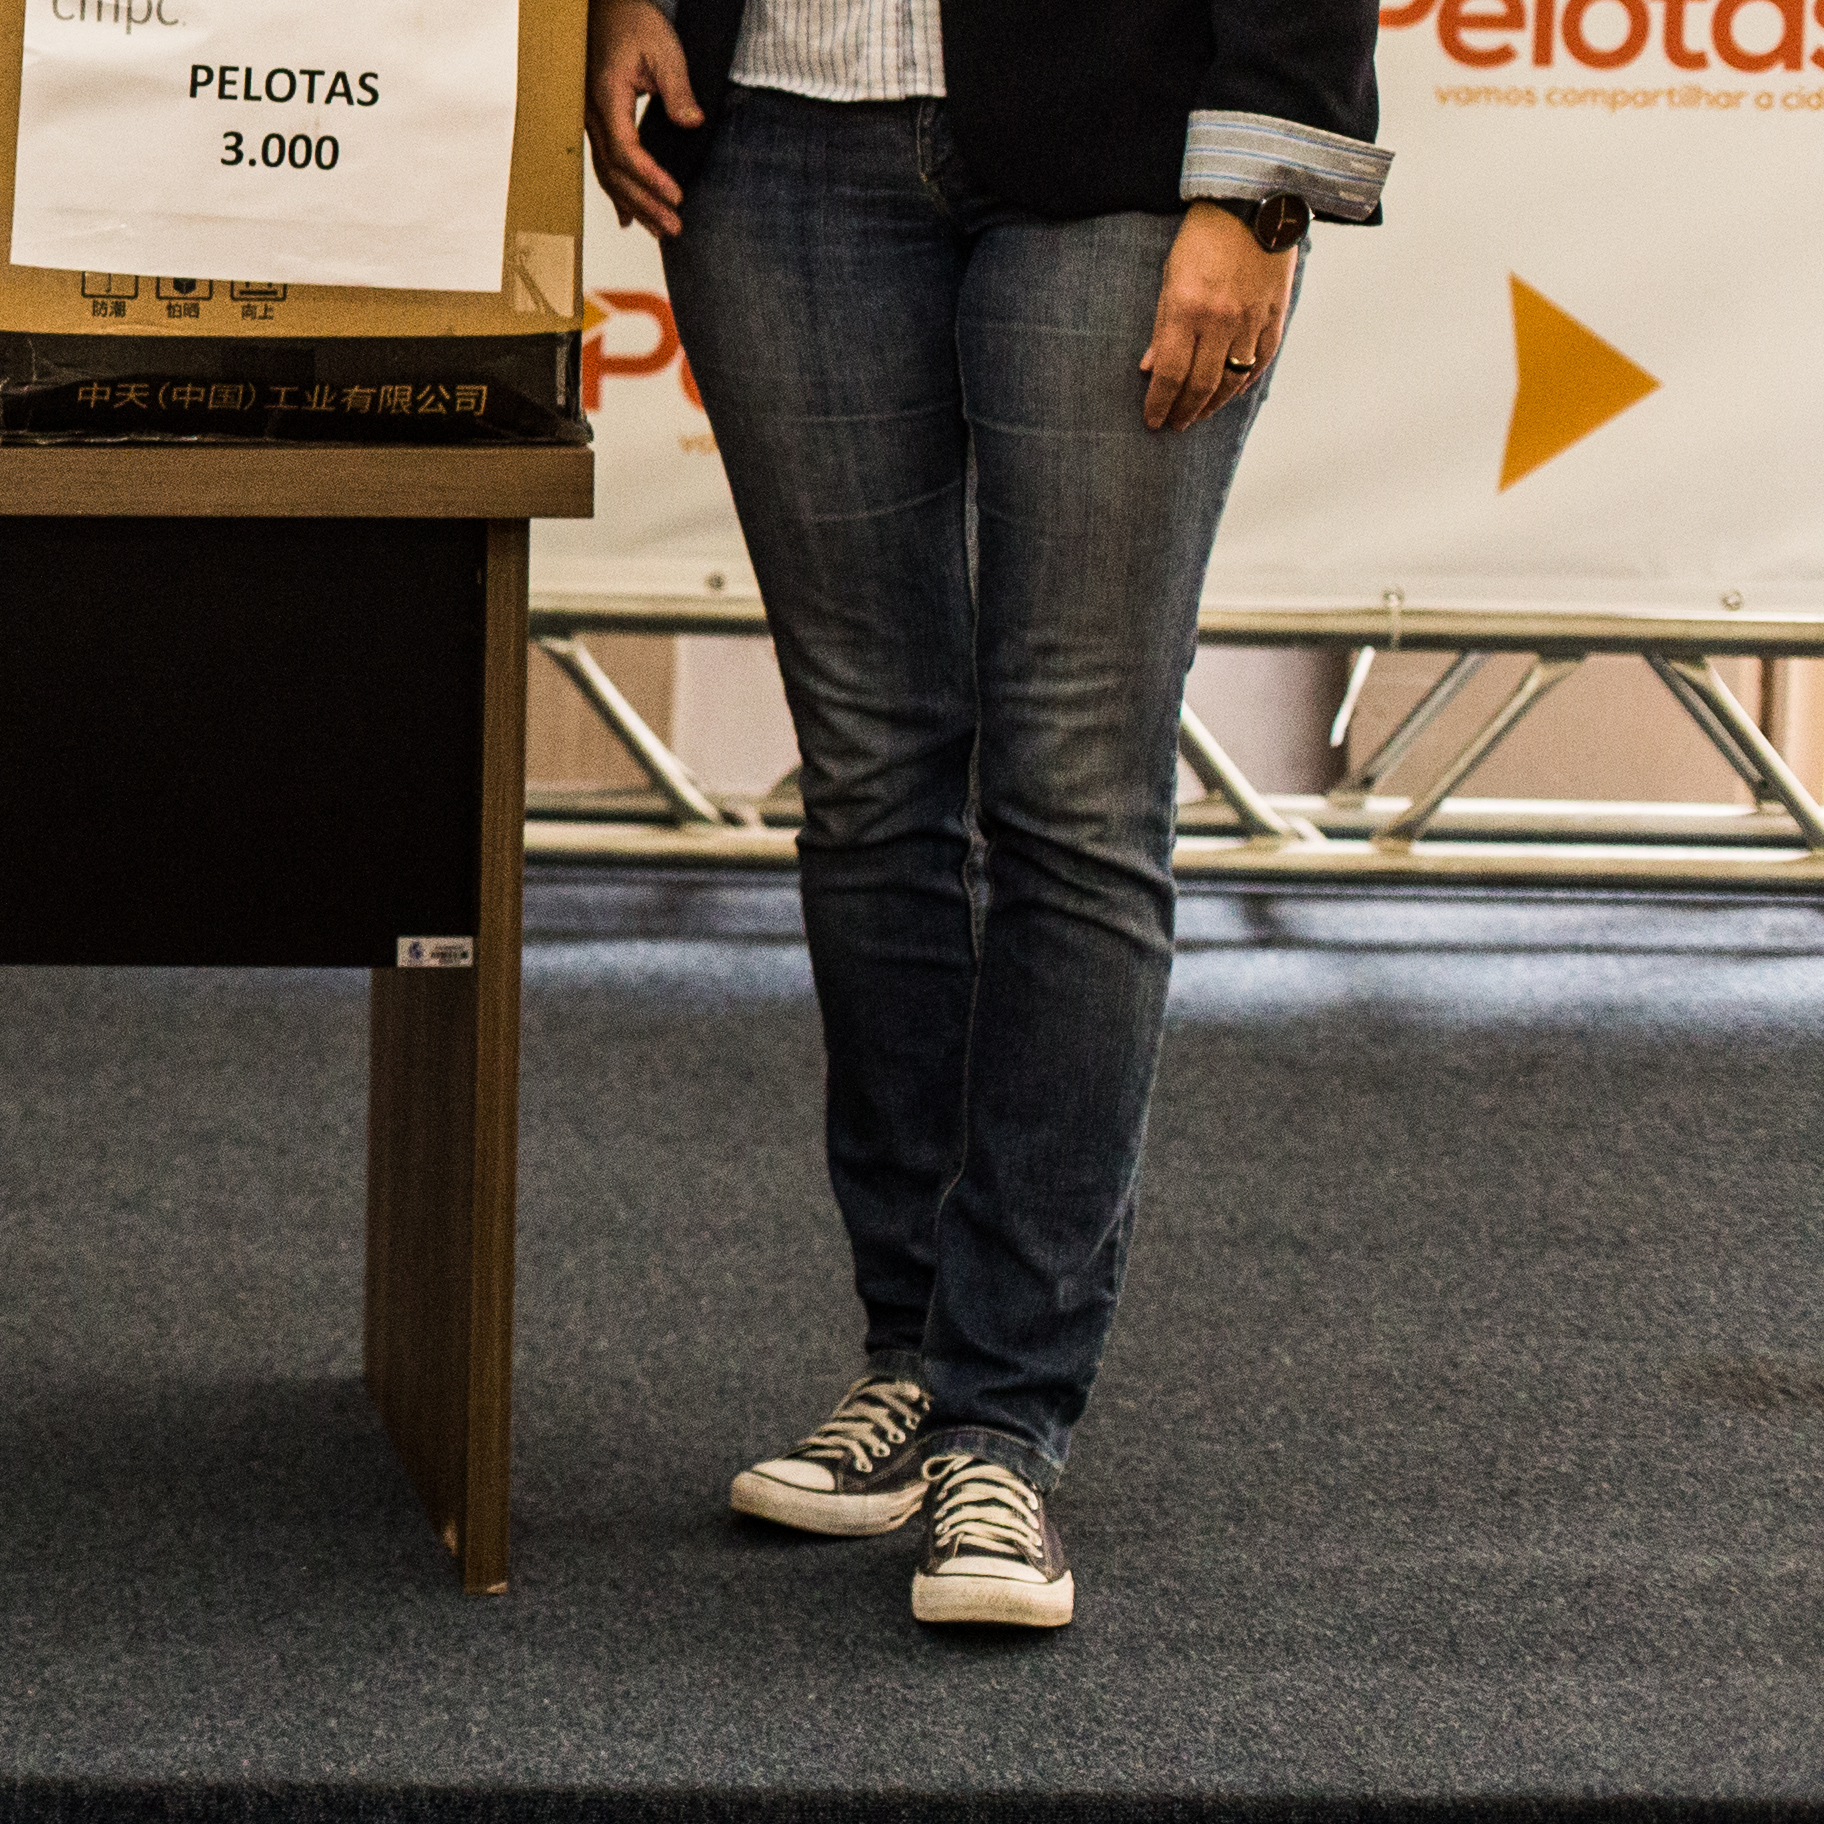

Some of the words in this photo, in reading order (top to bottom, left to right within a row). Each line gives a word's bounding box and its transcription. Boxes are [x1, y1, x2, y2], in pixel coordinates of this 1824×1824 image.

[189, 64, 380, 106] PELOTAS
[1435, 85, 1536, 106] vamos
[1545, 84, 1749, 113] compartilhar
[220, 131, 340, 171] 3.000
[91, 300, 126, 319] 防潮
[166, 302, 201, 320] 怕晒
[240, 303, 275, 321] 向上
